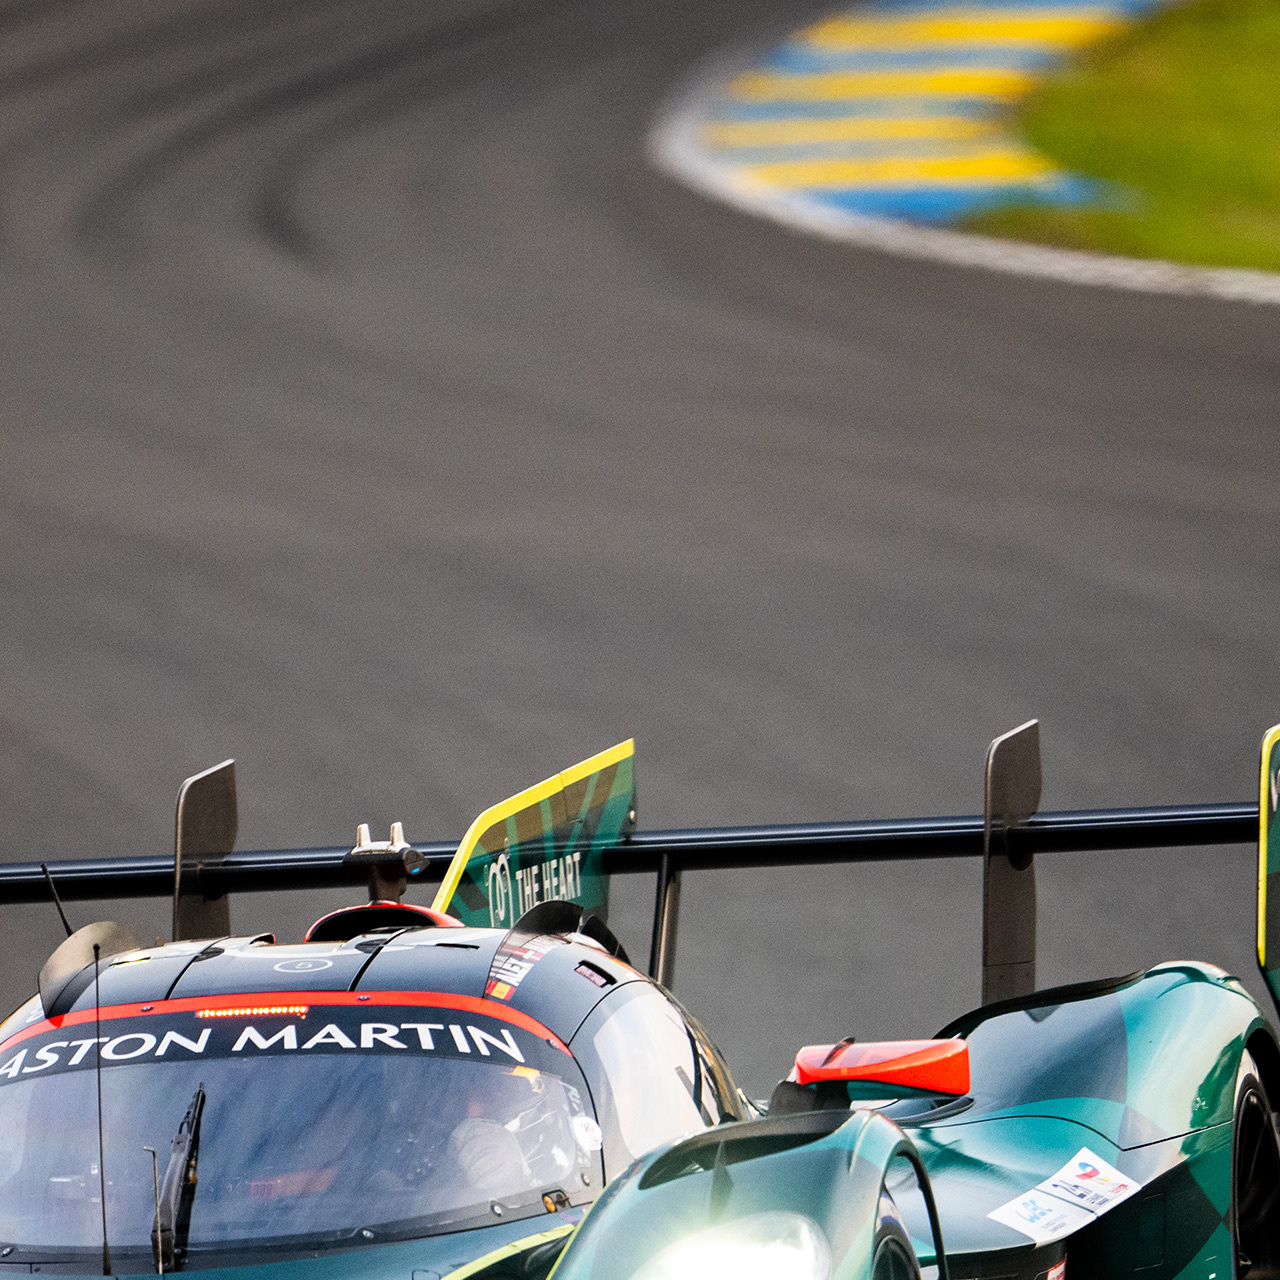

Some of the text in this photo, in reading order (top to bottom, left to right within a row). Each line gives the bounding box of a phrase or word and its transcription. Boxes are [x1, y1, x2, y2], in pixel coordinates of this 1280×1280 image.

[515, 851, 581, 916] THE HEART
[231, 1023, 526, 1063] MARTIN
